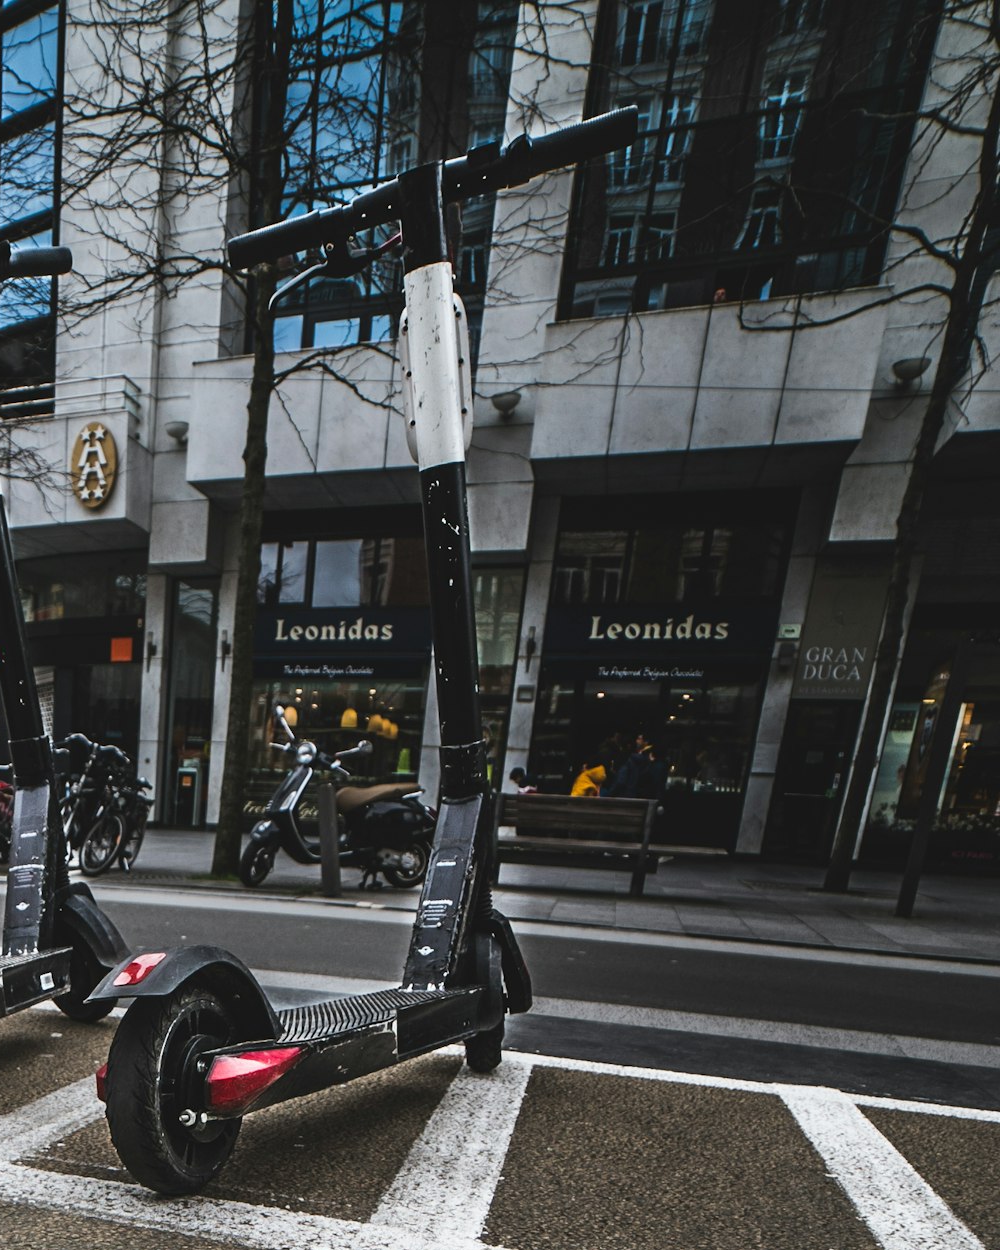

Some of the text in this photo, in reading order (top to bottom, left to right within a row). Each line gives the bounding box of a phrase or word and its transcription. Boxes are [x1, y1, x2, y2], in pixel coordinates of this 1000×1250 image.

[275, 616, 394, 641] Leonidas
[588, 613, 731, 640] Leonidas
[805, 646, 868, 664] GRAN
[283, 665, 293, 675] The
[293, 664, 321, 676] Preferred
[322, 664, 345, 678] Belgian
[598, 666, 609, 676] The
[609, 666, 641, 679] Preferred
[643, 666, 669, 680] Belgian
[802, 663, 862, 681] DUCA
